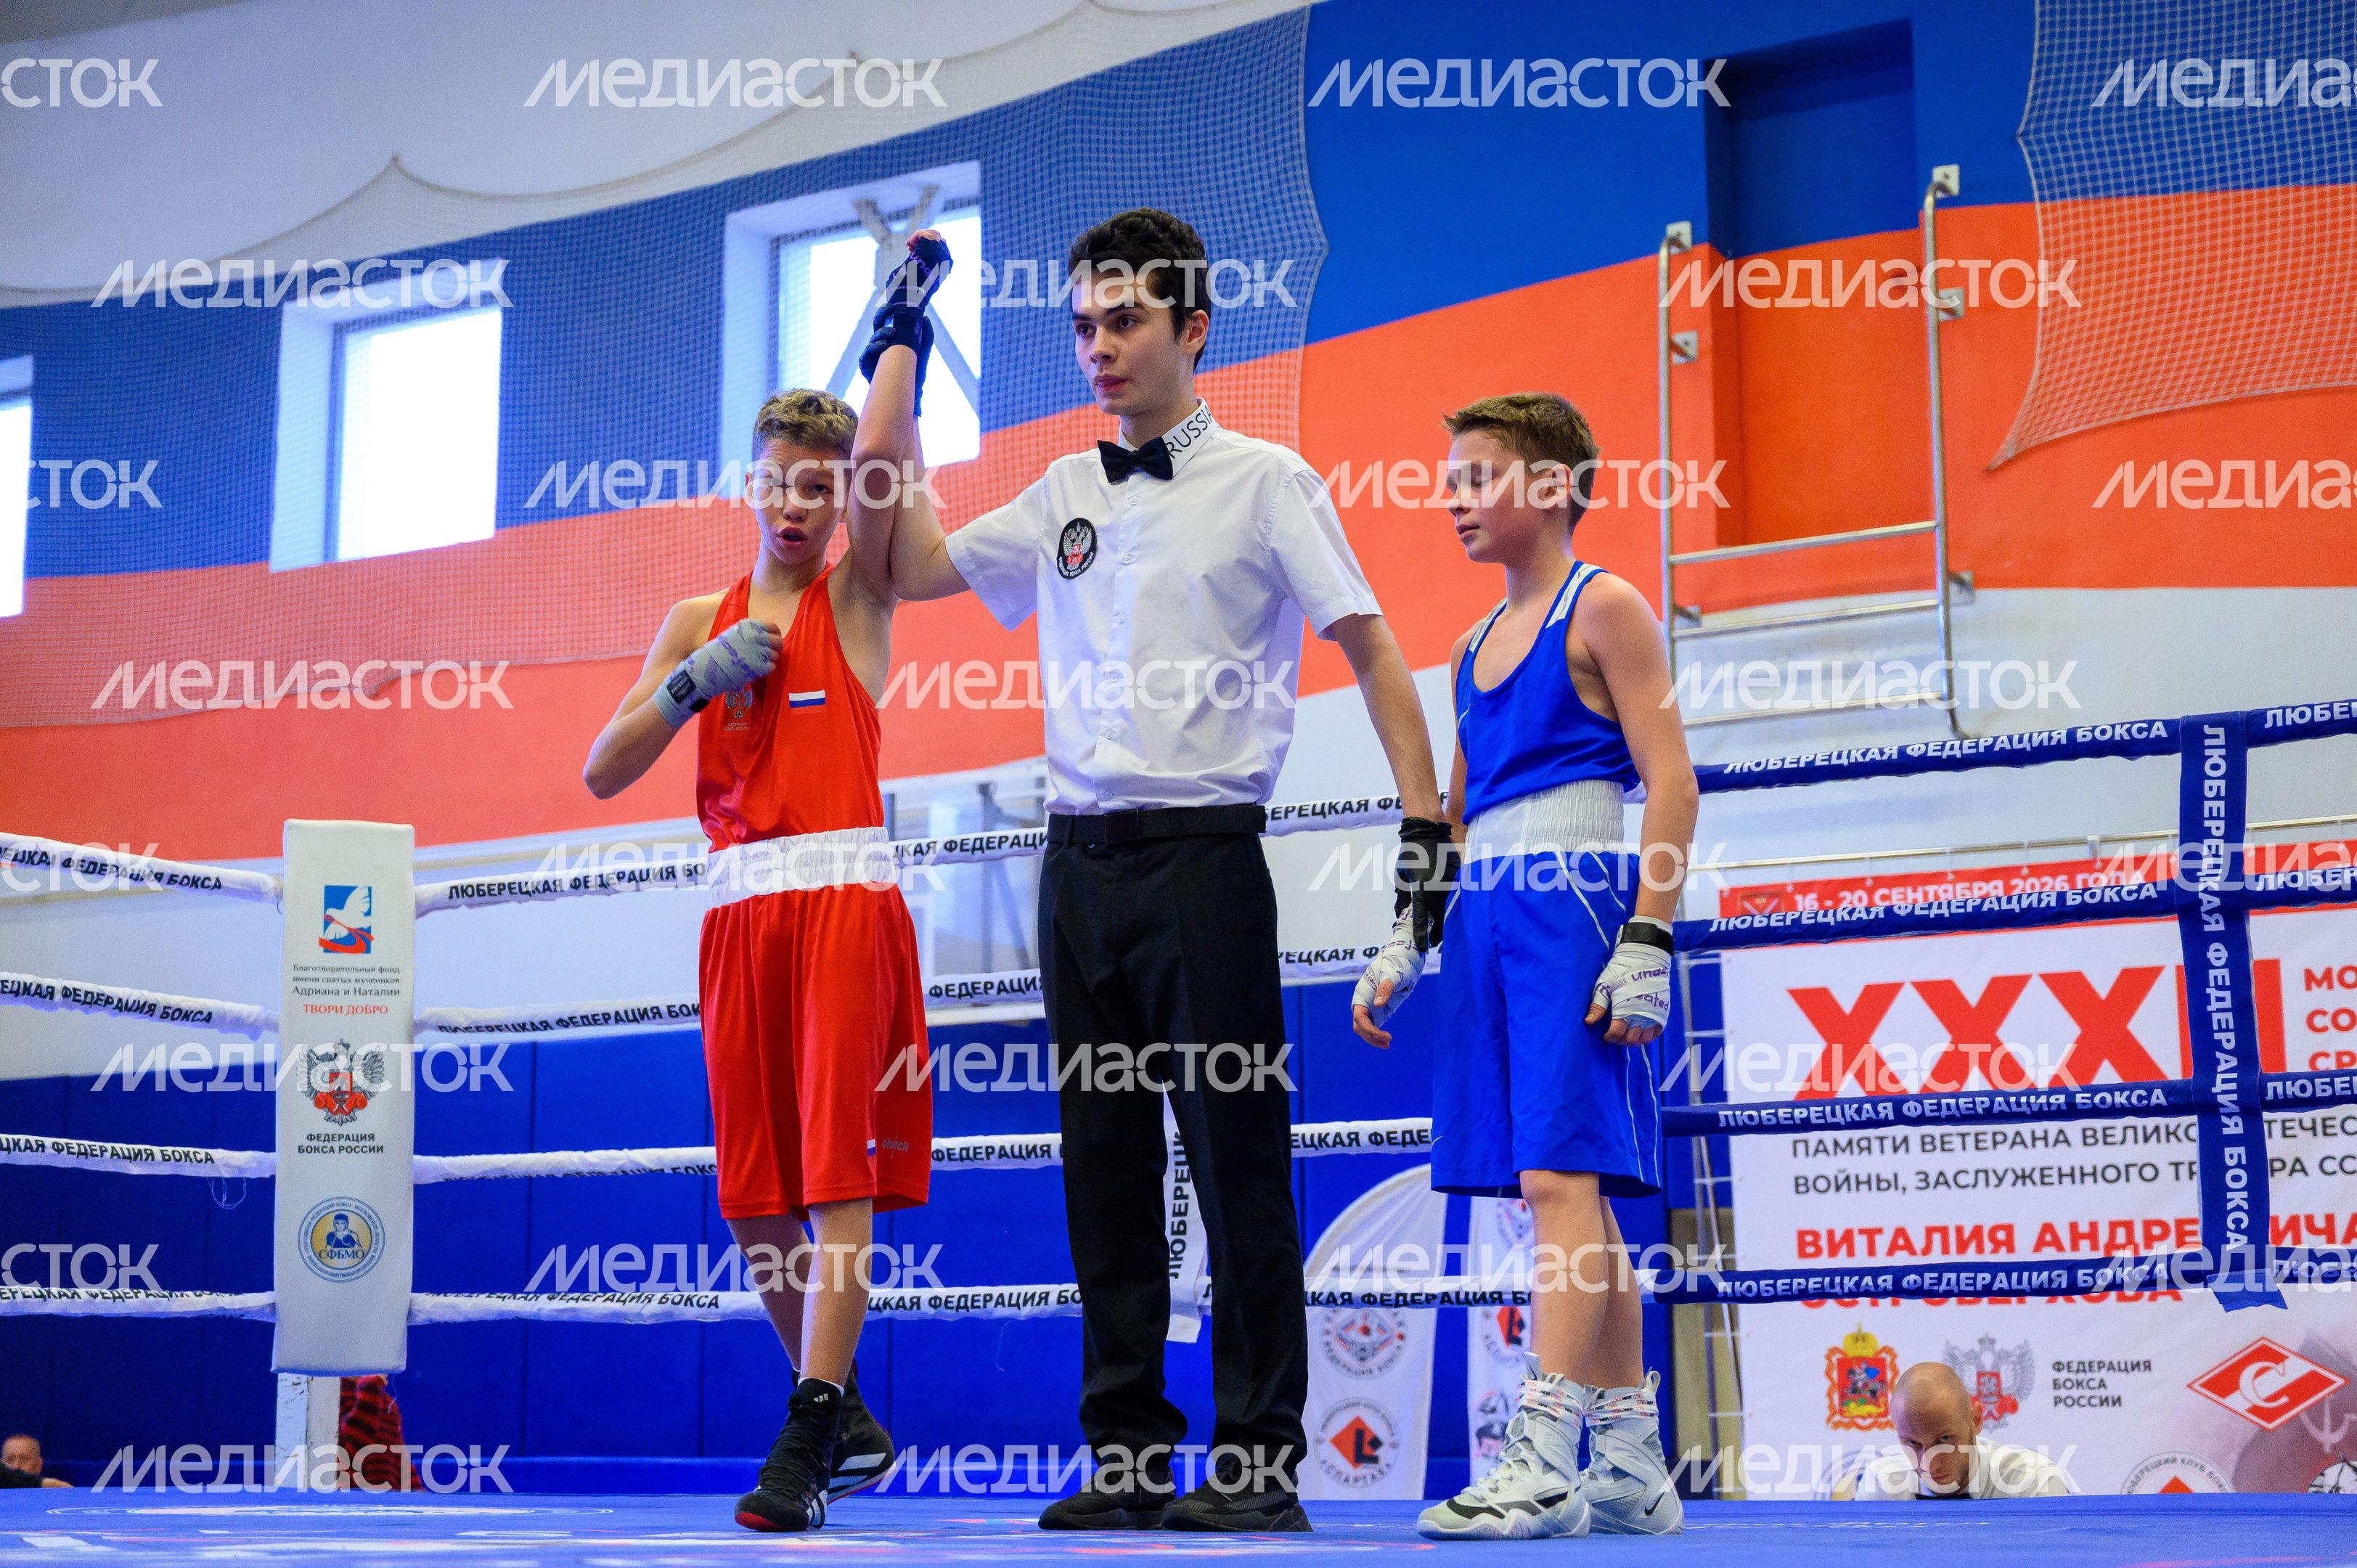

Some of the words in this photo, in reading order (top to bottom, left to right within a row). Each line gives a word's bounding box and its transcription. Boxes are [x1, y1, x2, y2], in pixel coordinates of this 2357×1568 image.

[1723, 746, 1898, 774] ЛЮБЕРЕЦКАЯ
[1906, 729, 2067, 759] ФЕДЕРАЦИЯ
[2076, 721, 2168, 743] БОКСА
[2197, 724, 2227, 931] ЛЮБЕРЕЦКАЯ
[944, 832, 1047, 855] ФЕДЕРАЦИ
[166, 873, 222, 891] БОКСА
[449, 878, 565, 900] ЛЮБЕРЕЦКАЯ
[569, 863, 677, 891] ФЕДЕРАЦИЯ
[1794, 893, 1819, 912] 16
[1838, 889, 1868, 909] 20
[1874, 879, 2004, 907] СЕНТЯБРЯ
[2010, 874, 2070, 895] 2026
[1709, 905, 1886, 932] ЛЮБЕРЕЦКАЯ
[1892, 890, 2058, 918] ФЕДЕРАЦИЯ
[2066, 882, 2158, 906] БОКСА
[293, 964, 376, 973] Благотворительный
[293, 986, 340, 997] Адриана
[354, 987, 400, 997] Наталии
[928, 976, 1042, 1000] ФЕДЕРАЦИ
[0, 980, 55, 1001] ЕЦКАЯ
[61, 985, 158, 1017] ФЕДЕРАЦИЯ
[159, 1005, 213, 1024] БОКСА
[303, 1003, 343, 1014] ТВОРИ
[346, 1005, 389, 1016] ДОБРО
[555, 1005, 662, 1029] ФЕДЕРАЦИЯ
[666, 1003, 701, 1018] БОК
[2206, 942, 2244, 1135] ФЕДЕРАЦИЯ
[1718, 1101, 1895, 1127] ЛЮБЕРЕЦКАЯ
[1902, 1094, 2067, 1119] ФЕДЕРАЦИЯ
[2075, 1088, 2169, 1109] БОКСА
[306, 1133, 375, 1143] ФЕДЕРАЦИЯ
[1368, 1128, 1432, 1148] ФЕДЕ
[1792, 1135, 1911, 1159] ПАМЯТИ
[1920, 1128, 2072, 1153] ВЕТЕРАНА
[2081, 1122, 2197, 1147] ВЕЛИКО
[2264, 1115, 2357, 1139] ТЕЧЕС
[51, 1140, 155, 1161] ФЕДЕРАЦИЯ
[160, 1149, 216, 1164] БОКСА
[298, 1145, 335, 1154] БОКСА
[338, 1146, 384, 1154] РОССИИ
[931, 1143, 1052, 1162] ФЕДЕРАЦИЯ
[1794, 1169, 1908, 1195] ВОЙНЫ,
[1914, 1163, 2160, 1191] ЗАСЛУЖЕННОГО
[2223, 1146, 2250, 1252] БОКСА
[1797, 1223, 2016, 1259] ВИТАЛИЯ
[318, 1249, 364, 1260] СФБМО
[1717, 1274, 1893, 1297] ЛЮБЕРЕЦКАЯ
[1901, 1269, 2068, 1294] ФЕДЕРАЦИЯ
[2078, 1262, 2170, 1289] БОКСА
[658, 1294, 719, 1309] БОКСА
[928, 1291, 1050, 1312] ФЕДЕРАЦИЯ
[1360, 1290, 1503, 1307] ФЕДЕРАЦИЯ
[2052, 1360, 2152, 1374] ФЕДЕРАЦИЯ
[2052, 1378, 2107, 1390] БОКСА
[2054, 1395, 2122, 1408] РОССИИ
